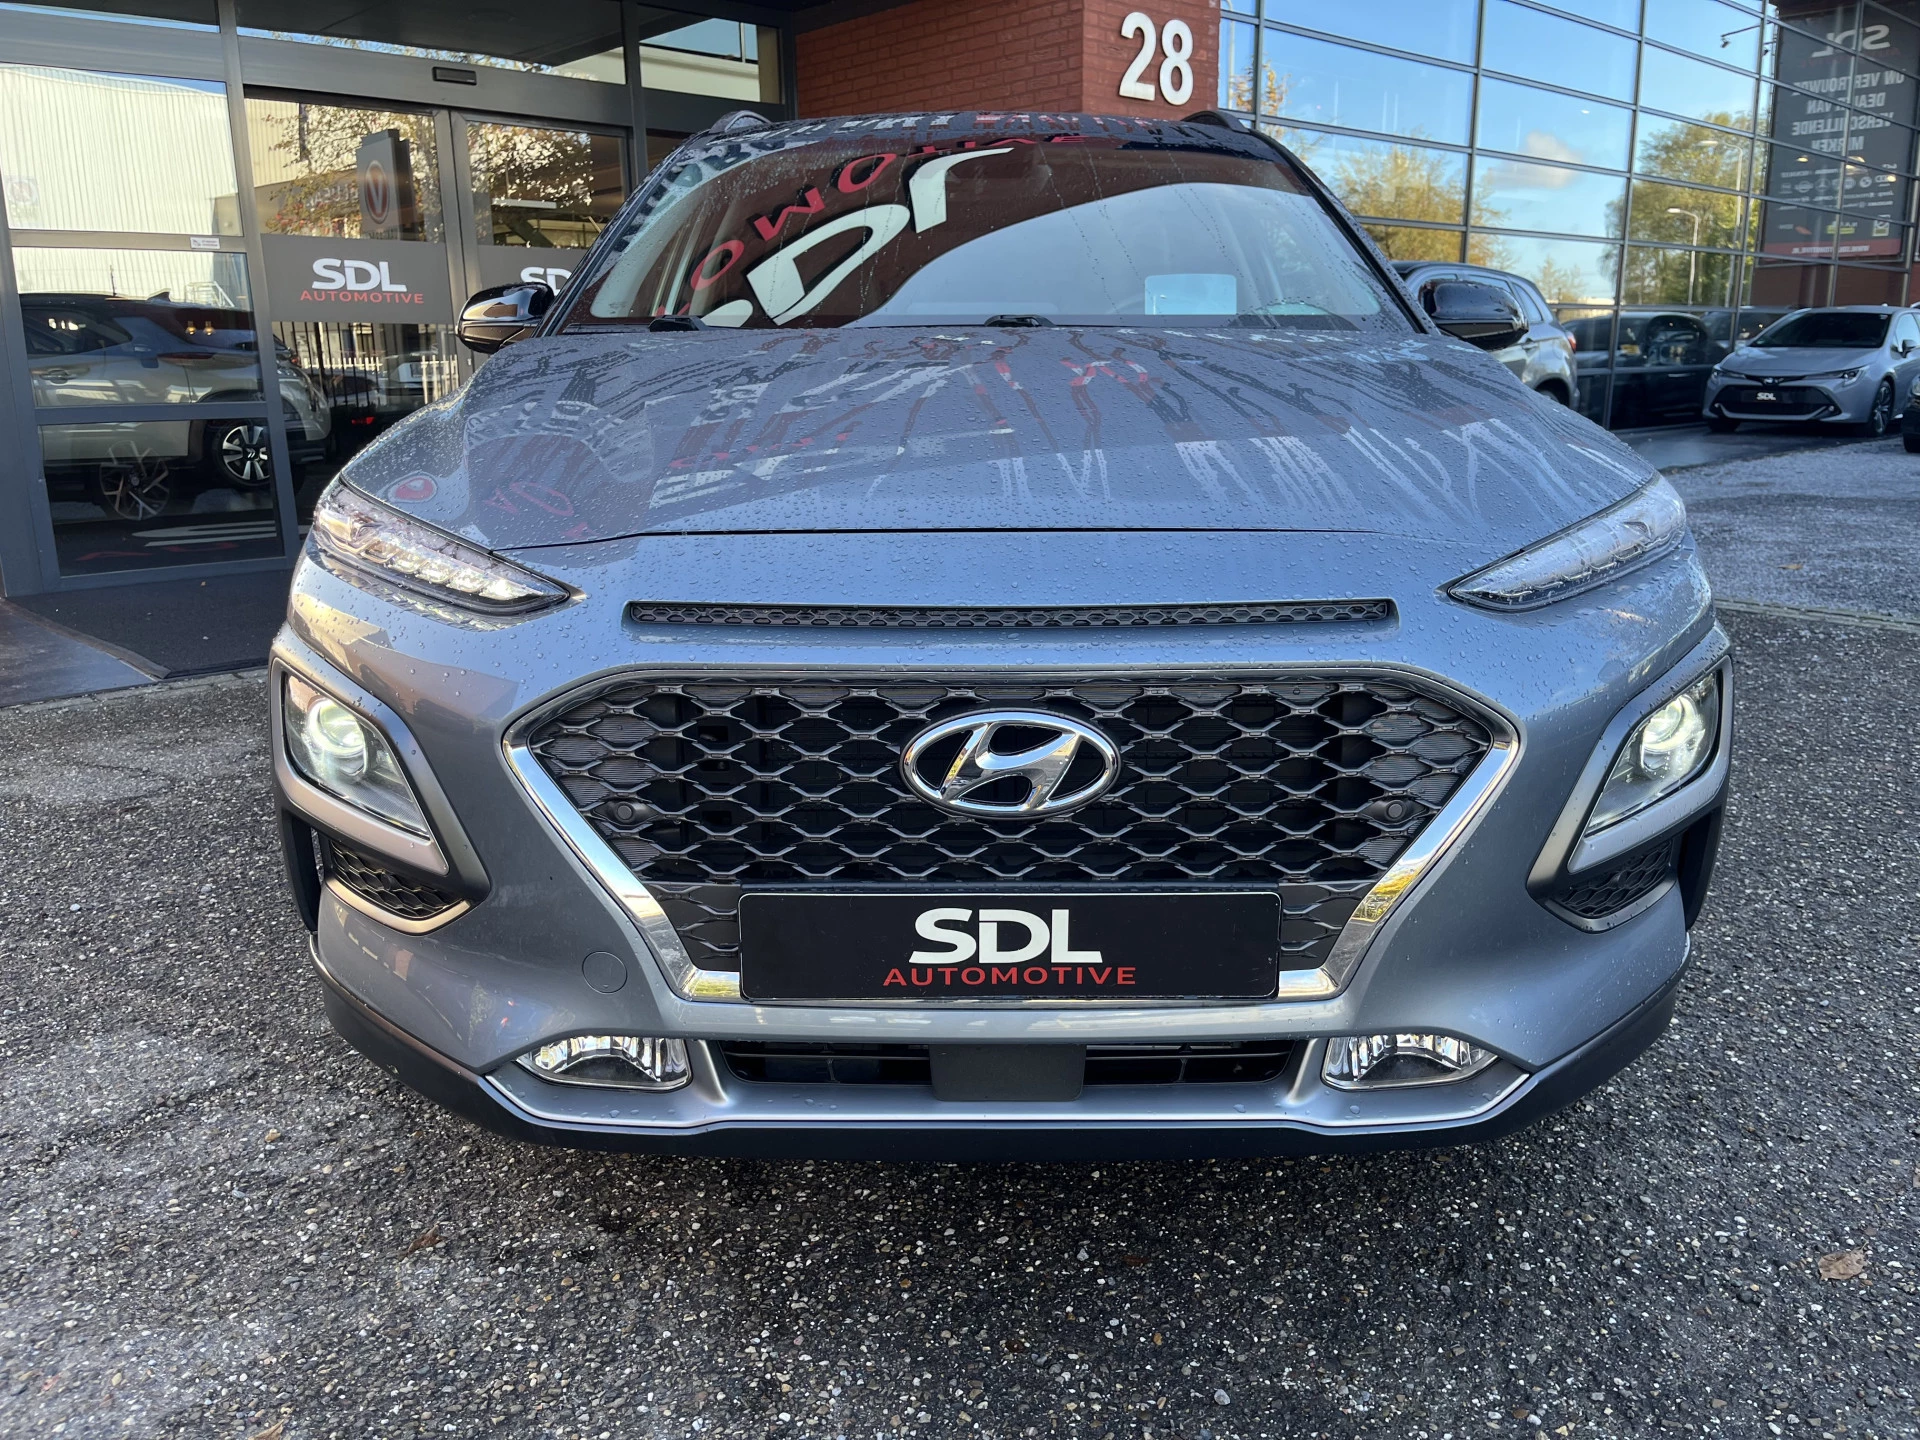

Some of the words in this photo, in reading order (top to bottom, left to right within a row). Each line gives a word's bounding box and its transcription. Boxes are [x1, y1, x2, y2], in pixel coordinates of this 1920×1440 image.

[1119, 12, 1194, 105] 28
[312, 258, 408, 292] SDL
[520, 266, 573, 297] SD
[300, 290, 425, 304] AUTOMOTIVE
[1757, 392, 1776, 400] SDL
[908, 907, 1103, 964] SDL
[883, 966, 1137, 986] AUTOMOTIVE
